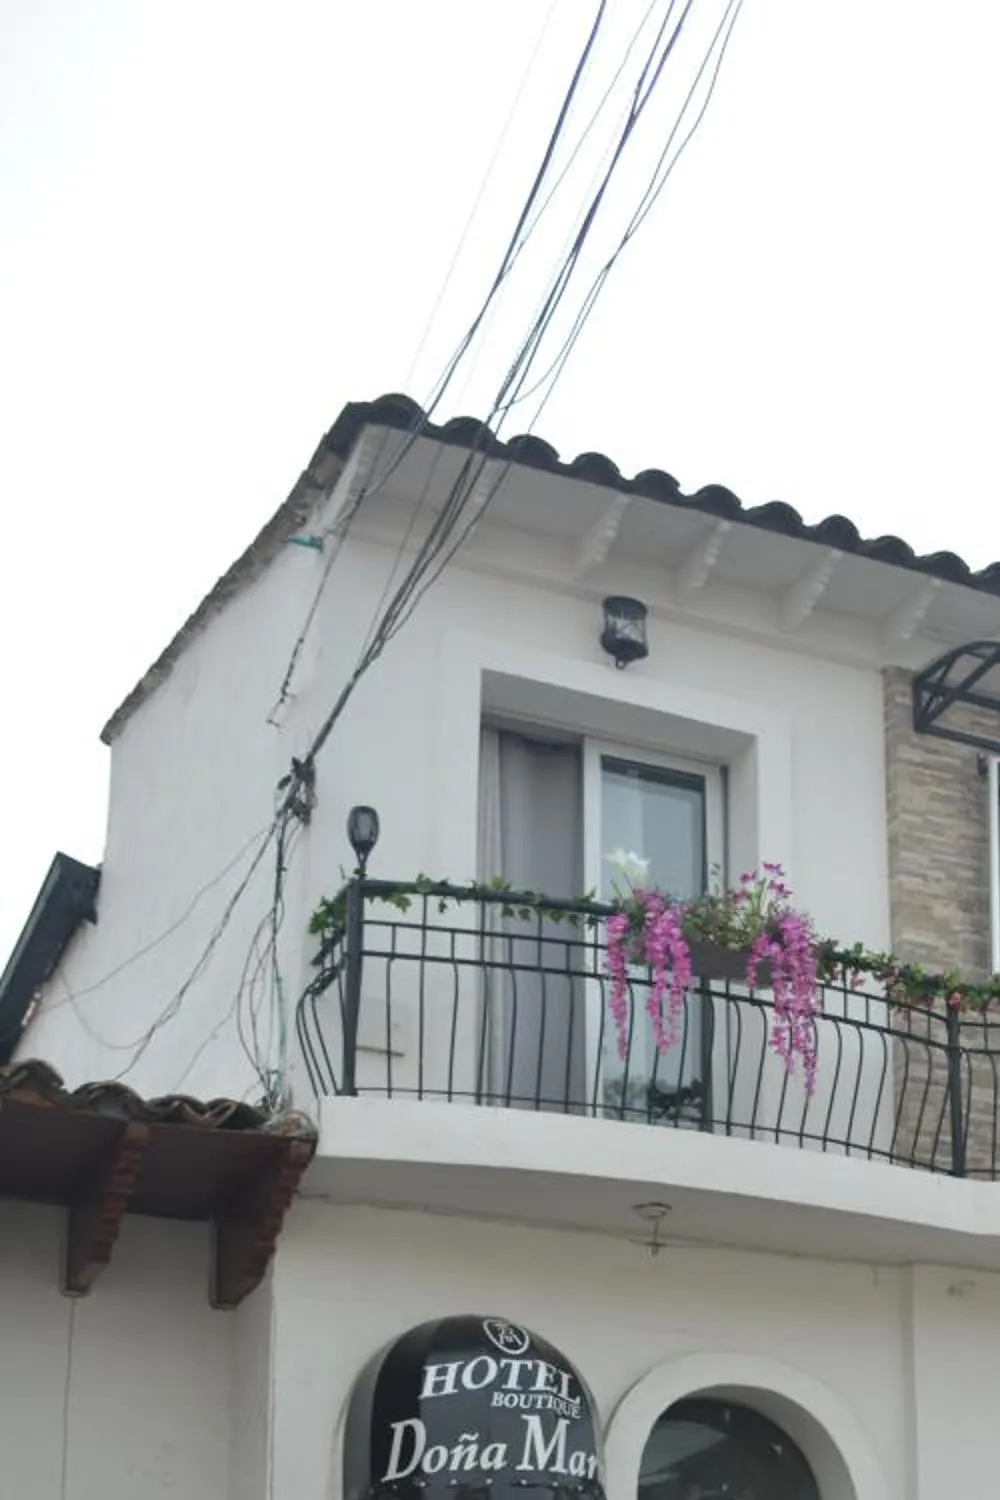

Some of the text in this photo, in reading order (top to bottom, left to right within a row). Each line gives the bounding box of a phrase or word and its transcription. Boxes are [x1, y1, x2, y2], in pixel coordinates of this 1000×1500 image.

[419, 1355, 581, 1405] HOTEL
[490, 1391, 582, 1420] BOUTIQUE
[380, 1417, 508, 1483] Doña
